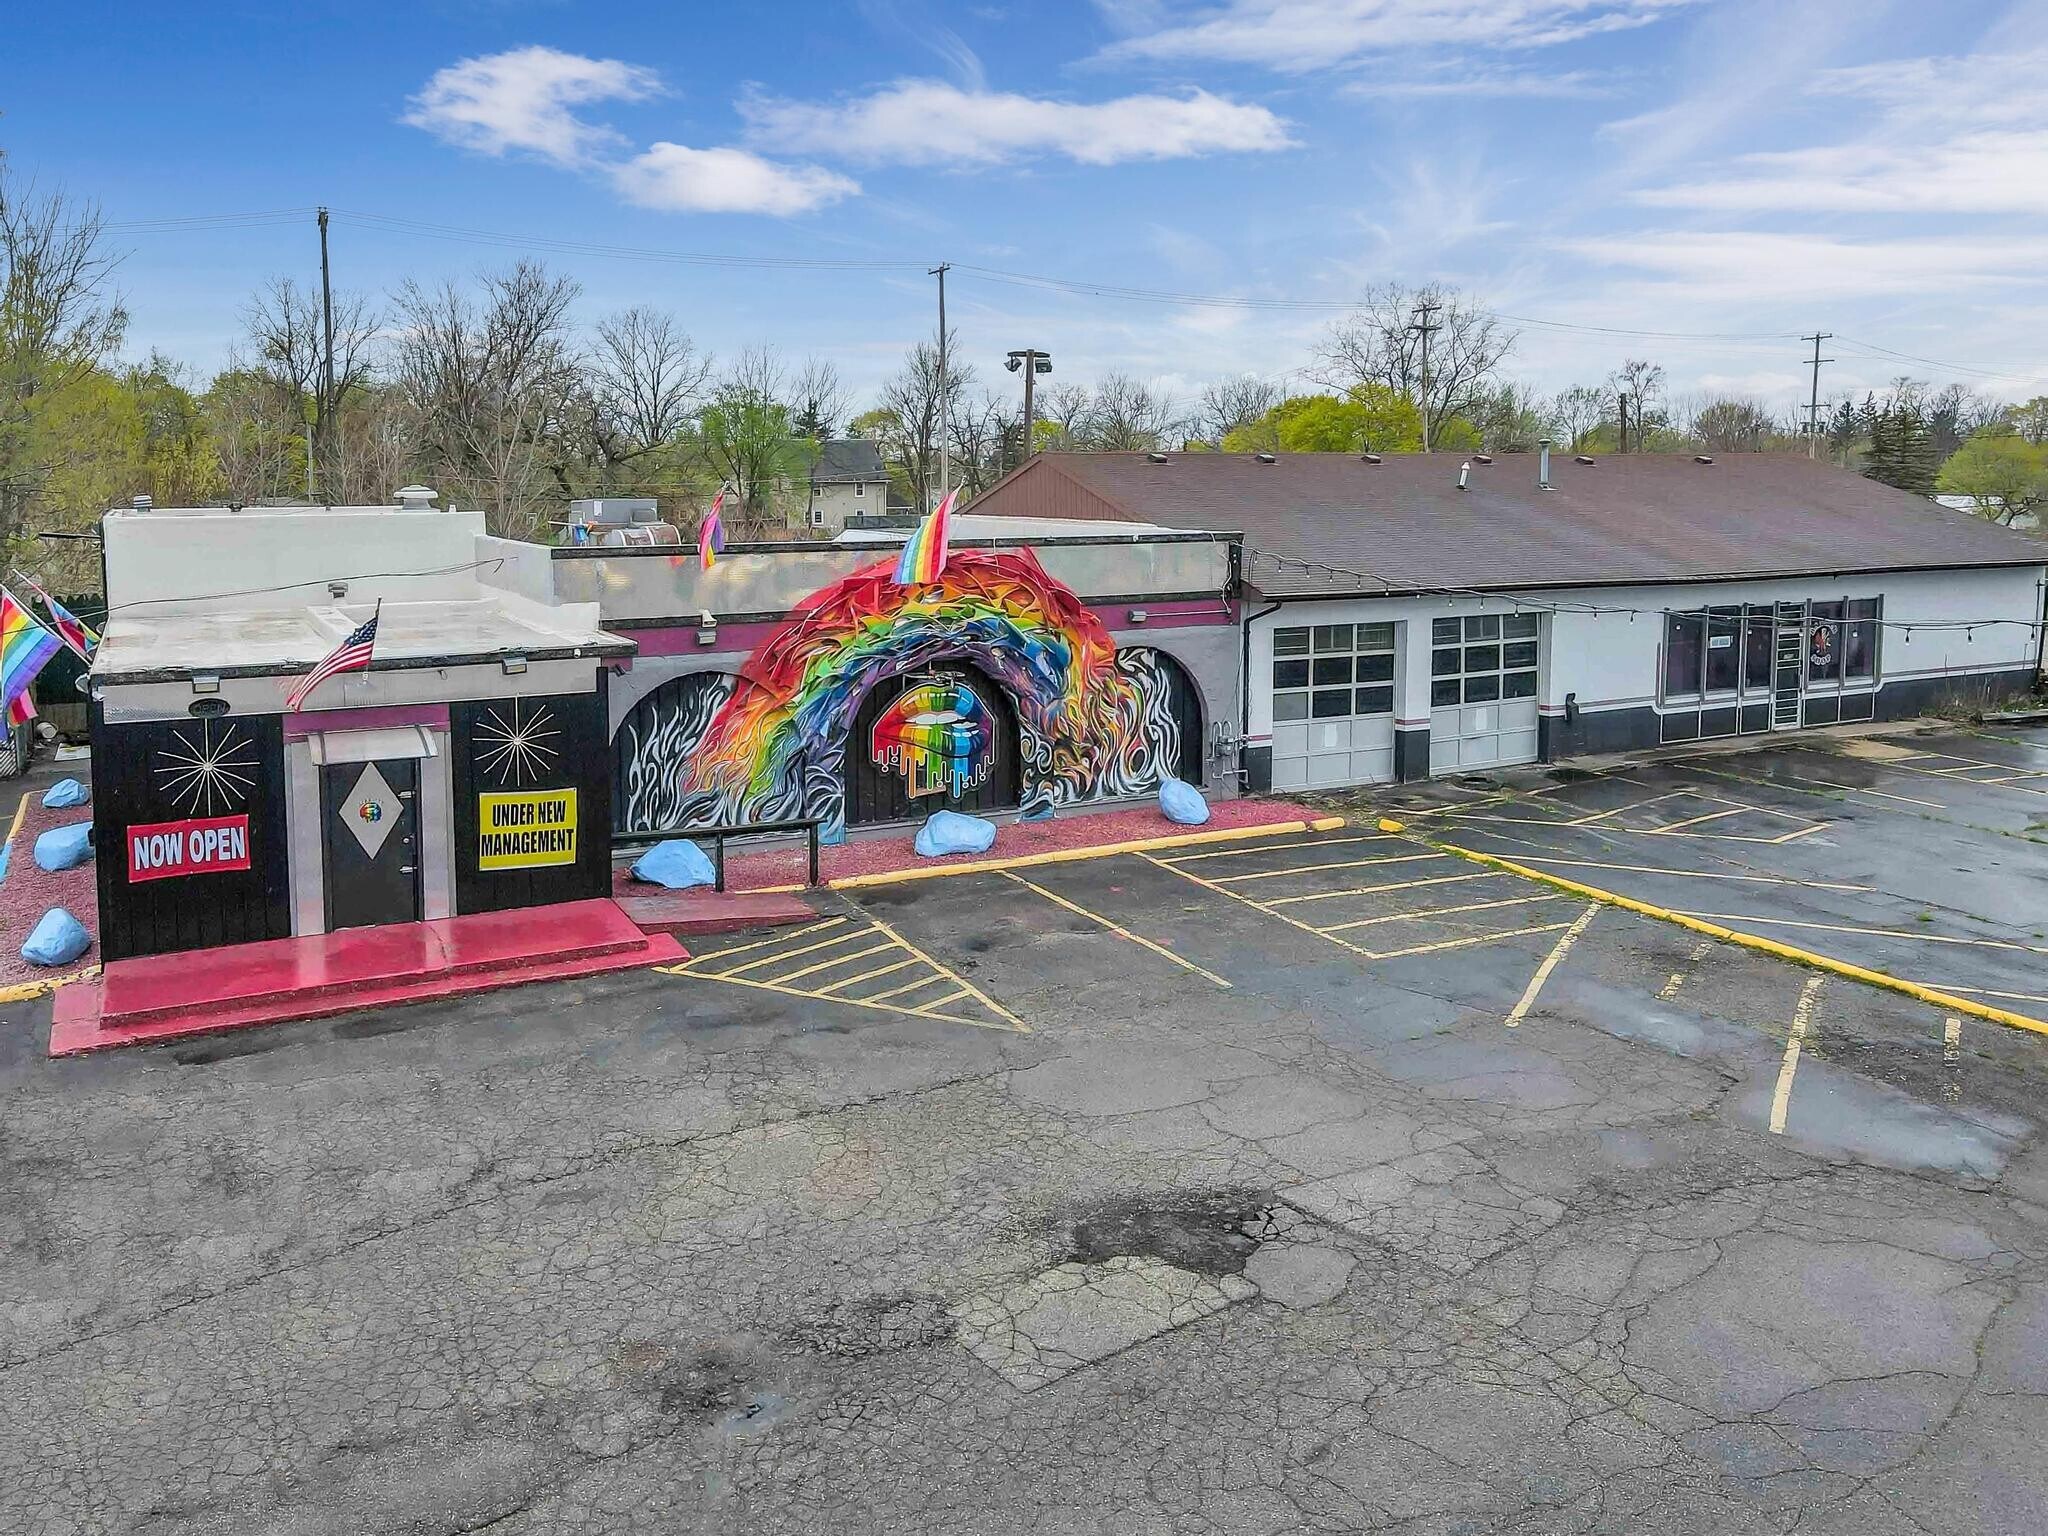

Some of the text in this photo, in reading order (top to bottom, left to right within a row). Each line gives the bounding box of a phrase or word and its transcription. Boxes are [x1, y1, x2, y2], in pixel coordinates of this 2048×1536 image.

[493, 800, 566, 827] UNDER NEW
[134, 826, 246, 870] NOW OPEN
[481, 828, 575, 857] MANAGEMENT
